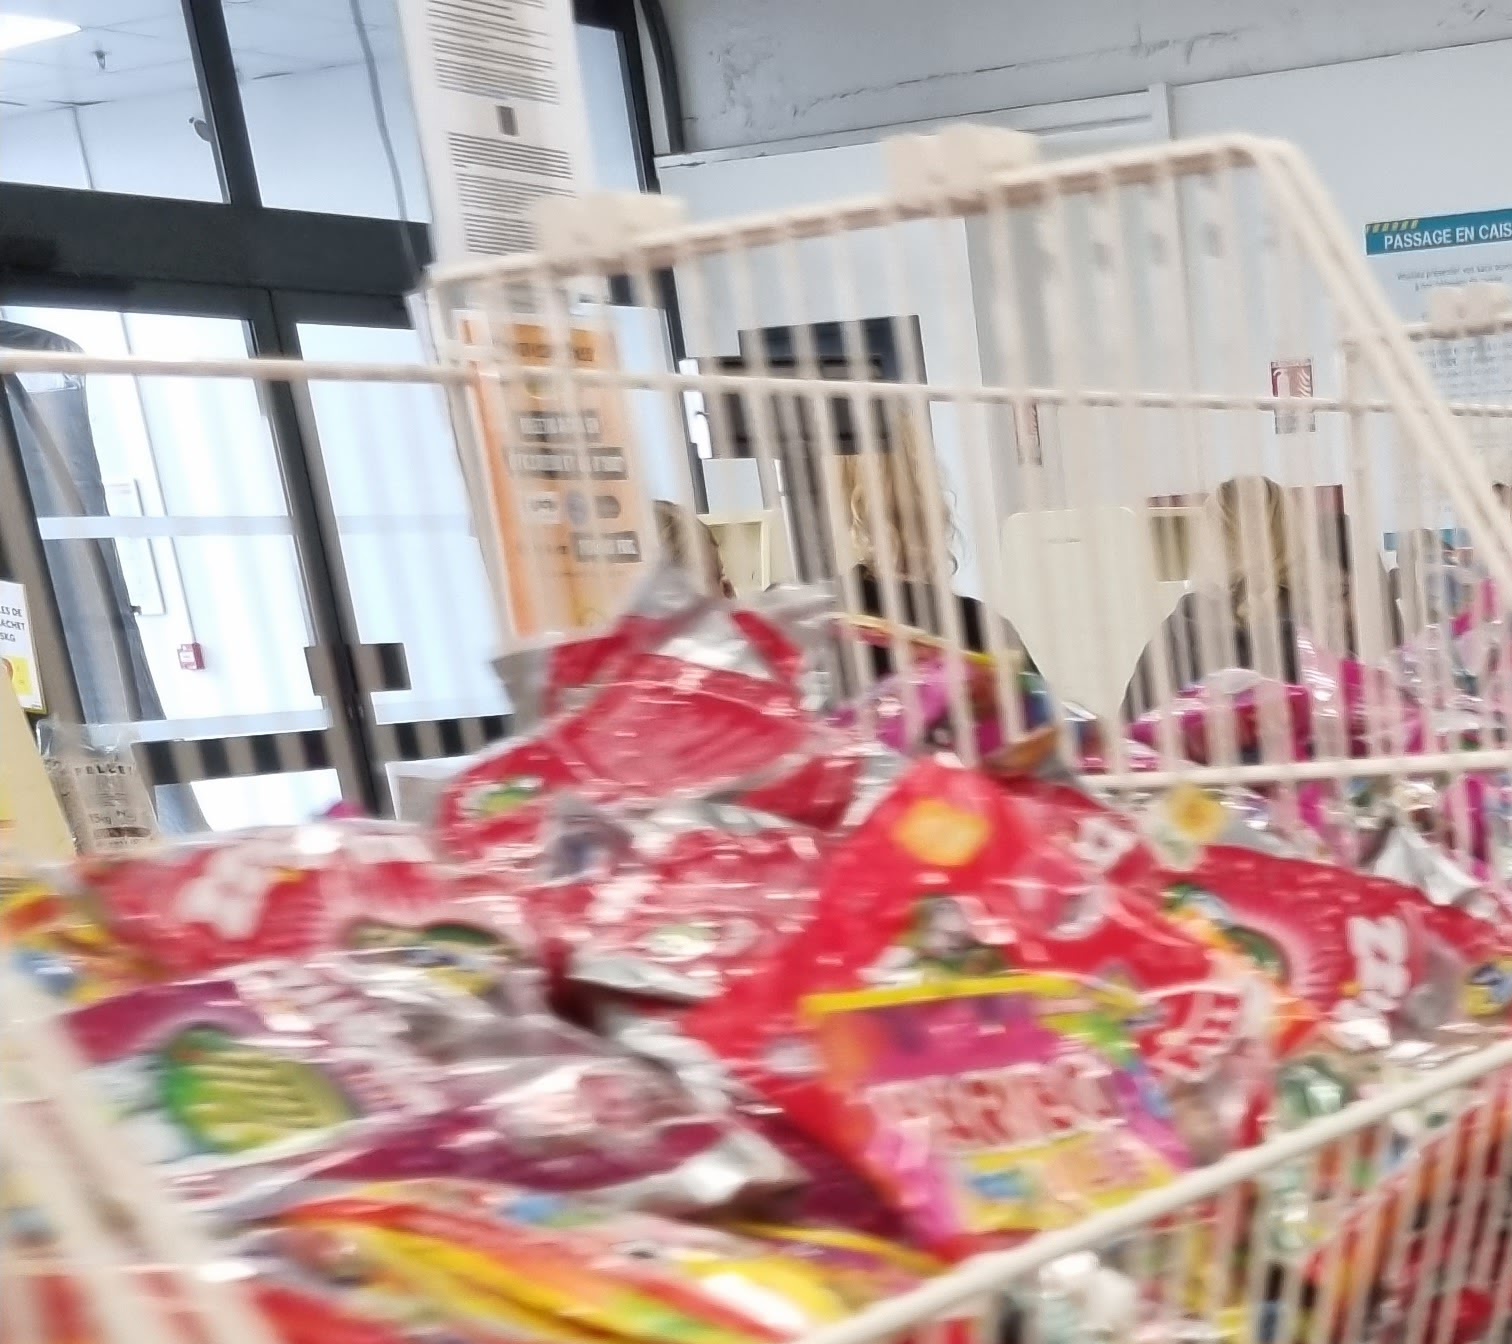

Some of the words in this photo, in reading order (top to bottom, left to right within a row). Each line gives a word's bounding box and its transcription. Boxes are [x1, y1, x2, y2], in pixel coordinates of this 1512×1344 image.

[1384, 227, 1451, 250] PASSAGE
[1456, 226, 1475, 243] EN
[0, 619, 25, 630] ACHET
